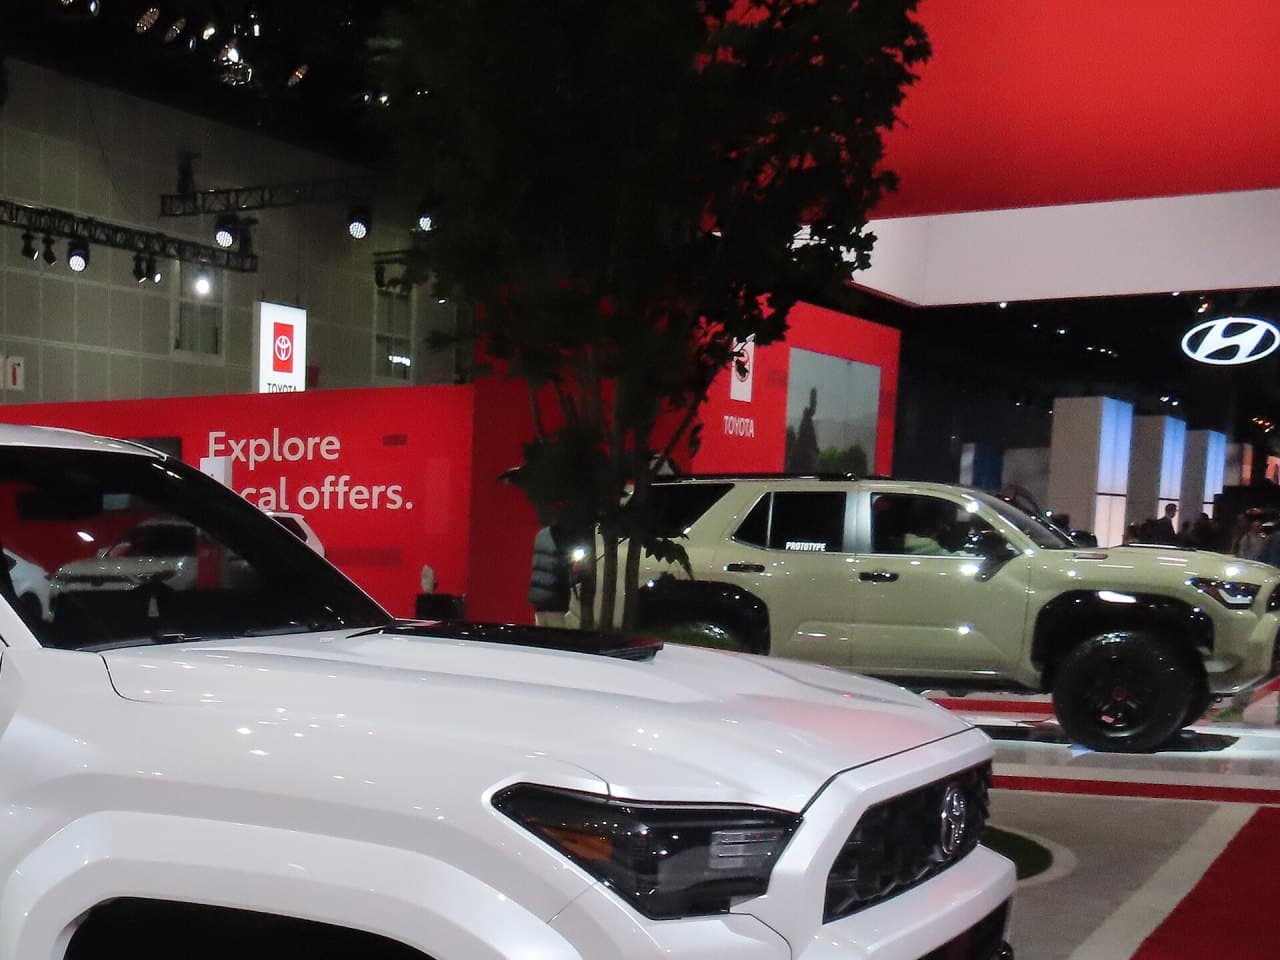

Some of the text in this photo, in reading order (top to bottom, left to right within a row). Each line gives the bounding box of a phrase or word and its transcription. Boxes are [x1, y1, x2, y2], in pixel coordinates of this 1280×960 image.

[723, 415, 755, 438] TOYOTA
[208, 427, 341, 471] Explore
[239, 475, 413, 511] cal offers.
[785, 541, 827, 552] PROTOTYPE
